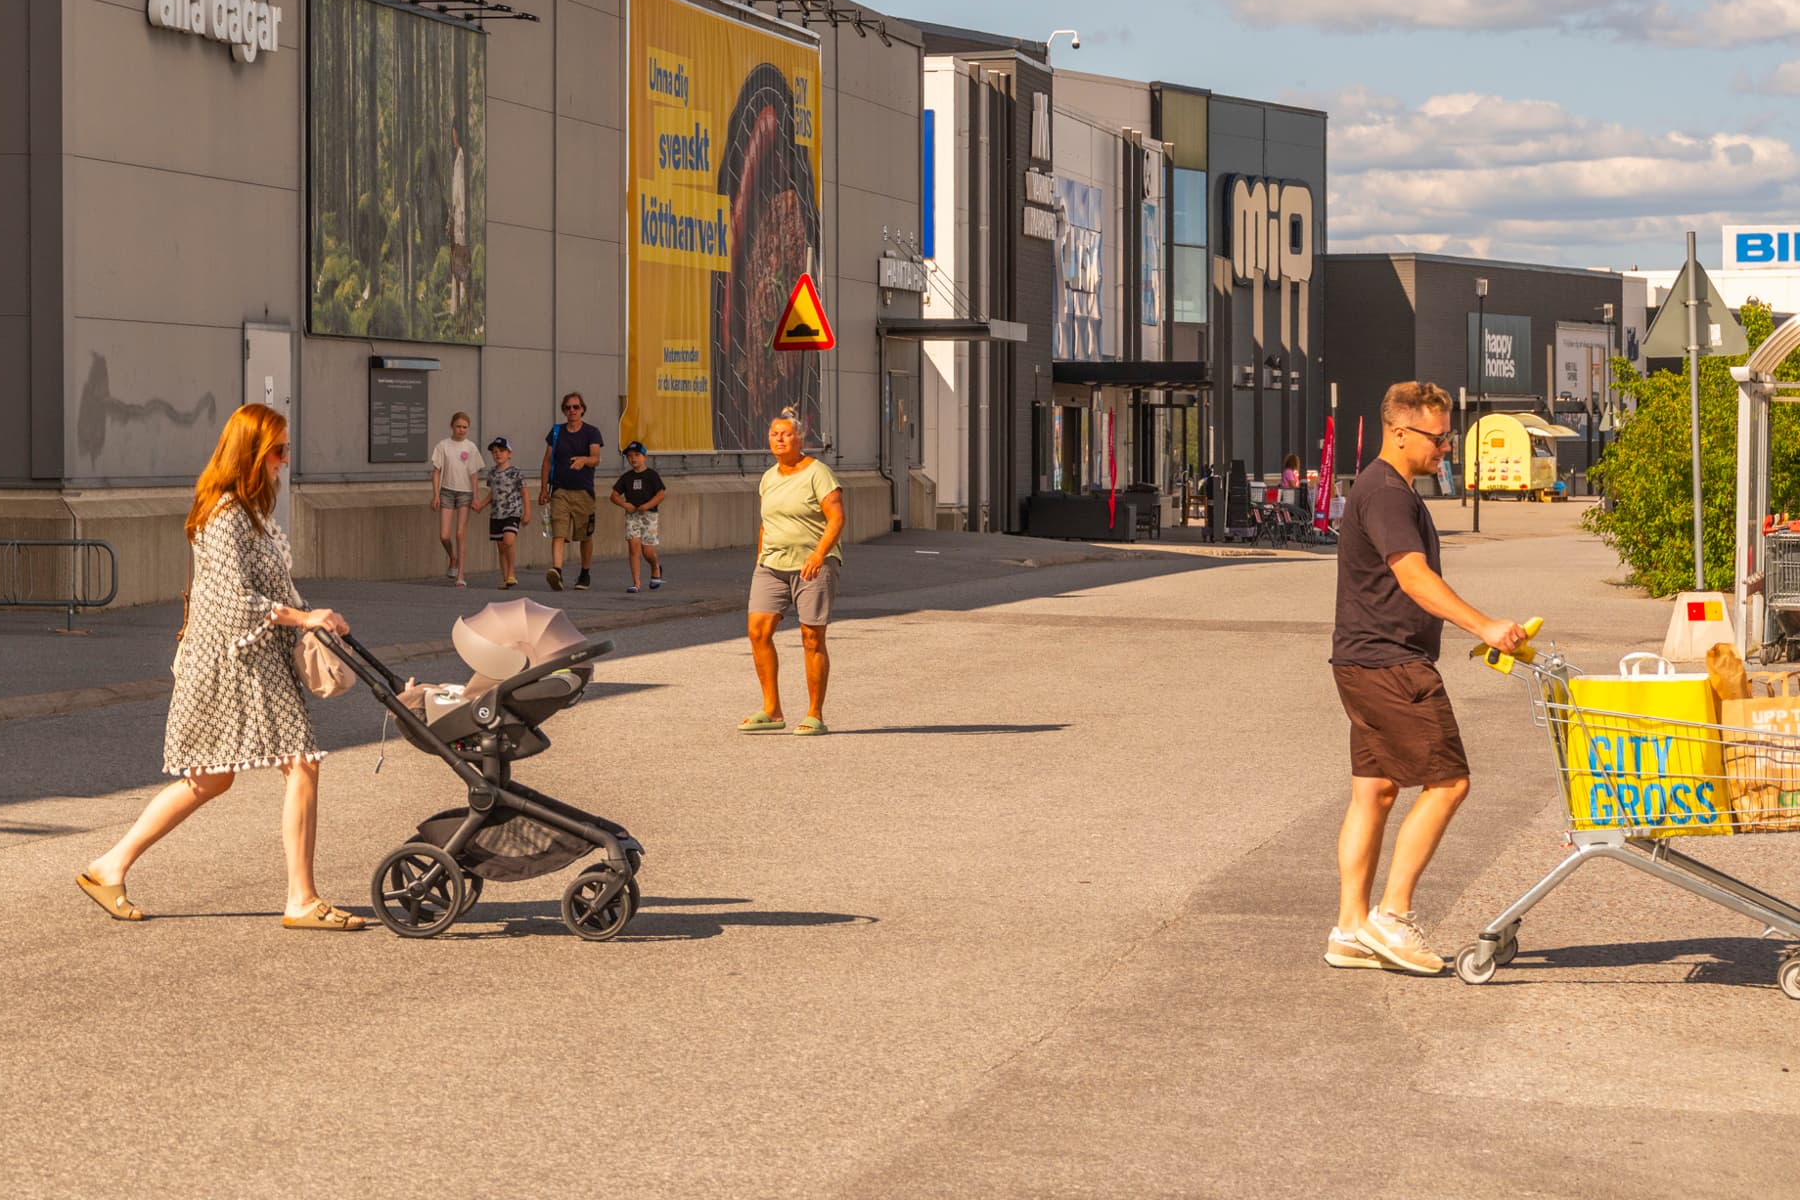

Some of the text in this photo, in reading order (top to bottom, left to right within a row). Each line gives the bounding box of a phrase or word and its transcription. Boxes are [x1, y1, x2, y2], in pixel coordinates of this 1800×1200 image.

[649, 57, 689, 107] Unna dig
[659, 122, 710, 172] svenskt
[1736, 232, 1800, 263] BI
[1485, 328, 1513, 358] happy
[1485, 356, 1515, 378] homes
[1752, 709, 1787, 723] UPP
[1589, 736, 1673, 780] CITY
[1590, 781, 1718, 826] GROSS
